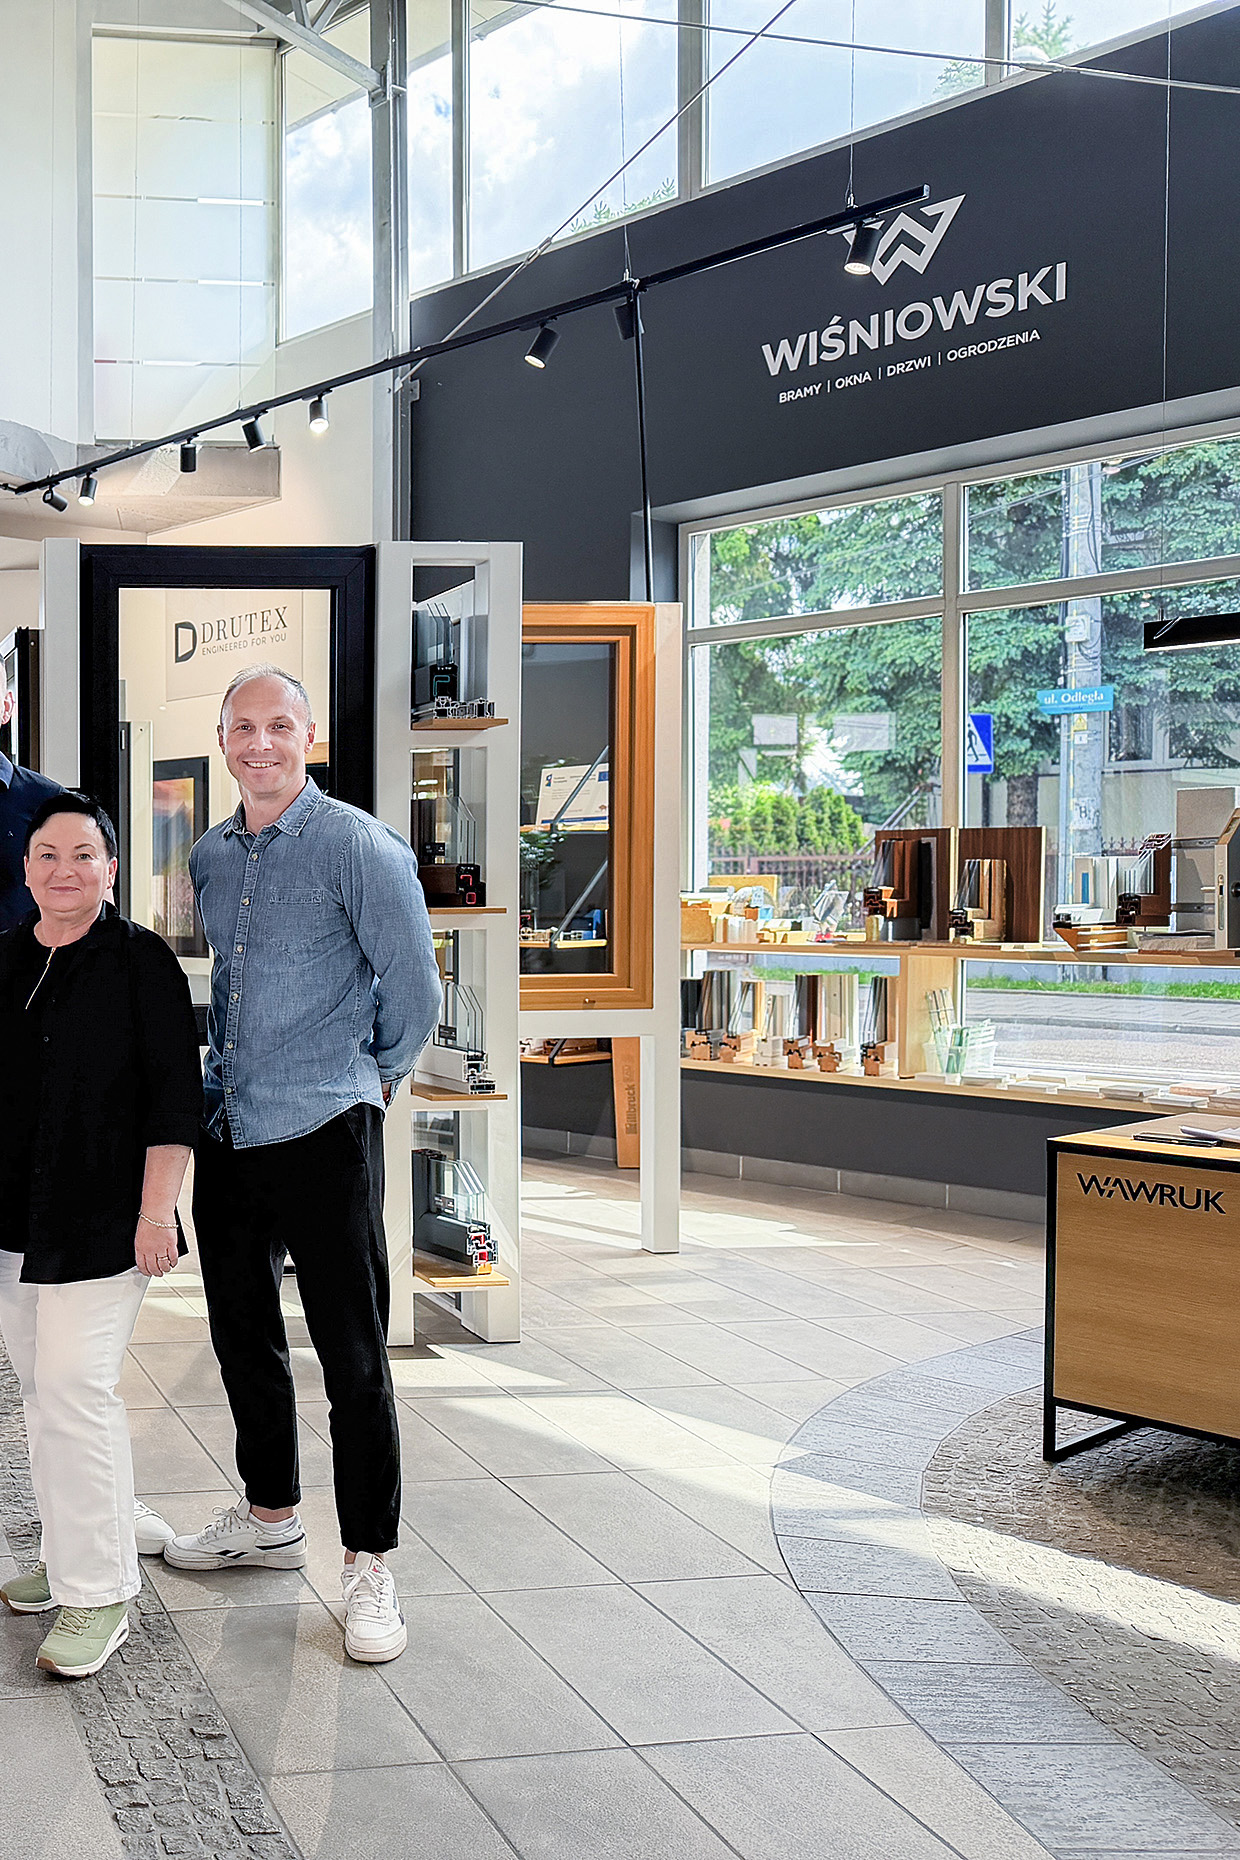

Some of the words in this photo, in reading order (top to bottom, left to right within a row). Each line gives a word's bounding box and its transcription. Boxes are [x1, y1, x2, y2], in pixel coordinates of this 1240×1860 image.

[761, 261, 1067, 377] WIŚNIOWSKI
[778, 382, 823, 404] BRAMY
[834, 371, 873, 390] OKNA
[886, 355, 932, 378] DRZWI
[946, 329, 1041, 362] OGRODZENIA
[201, 605, 288, 645] DRUTEX
[201, 640, 249, 656] ENGINEERED
[250, 635, 267, 648] FOR
[269, 632, 287, 644] YOU
[1044, 693, 1058, 705] ul.
[1061, 690, 1104, 704] Odległa
[1076, 1172, 1227, 1215] WAWRUK
